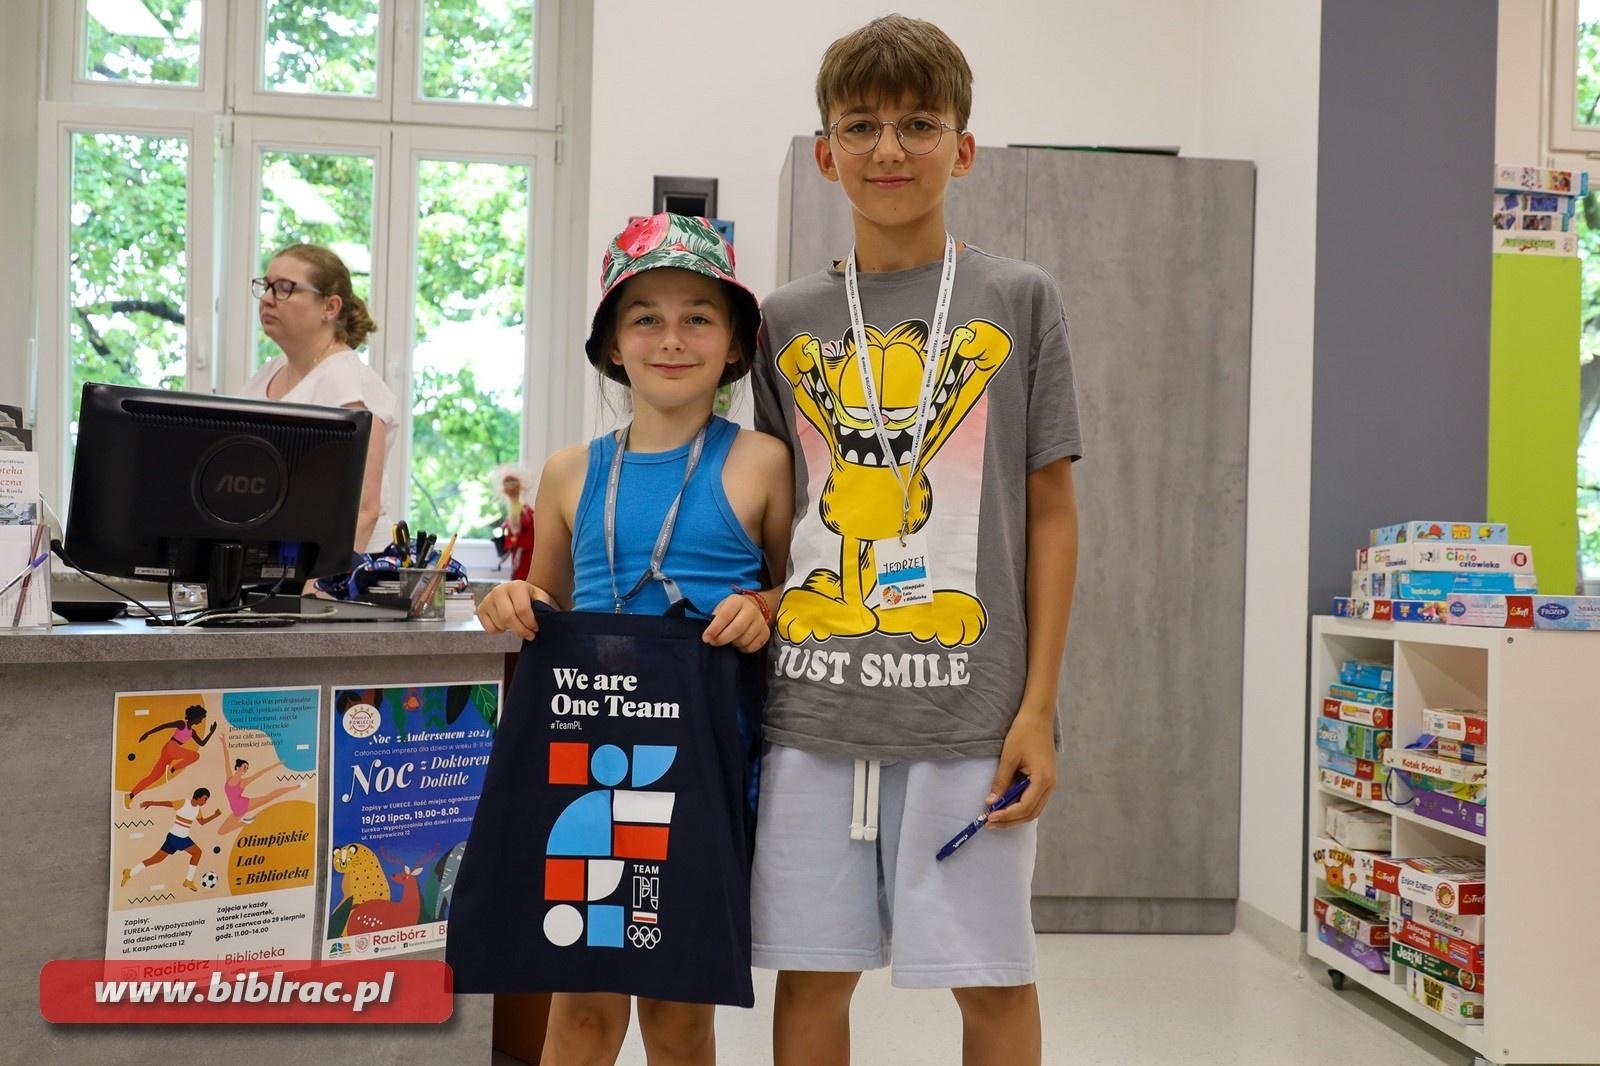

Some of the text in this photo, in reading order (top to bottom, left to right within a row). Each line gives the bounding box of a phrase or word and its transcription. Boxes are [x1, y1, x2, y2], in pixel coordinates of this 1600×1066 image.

[216, 475, 266, 494] AOC
[774, 646, 971, 688] JUST SMILE
[552, 667, 638, 691] We are
[551, 693, 680, 719] One Team
[550, 720, 582, 731] #TeamPL
[369, 733, 391, 745] Noc
[402, 730, 465, 743] Andersenem
[467, 729, 490, 739] 2024
[418, 744, 429, 752] dla
[420, 762, 428, 770] z
[1402, 758, 1442, 775] Kotek Psotek
[342, 758, 415, 803] Noc
[420, 772, 470, 789] Dolittle
[361, 807, 460, 825] 19/20 lipca, 19.00-8.00
[237, 831, 309, 849] Olimpijskie
[236, 854, 265, 867] Lato
[236, 867, 310, 886] z Biblioteką
[633, 864, 660, 875] TEAM
[1382, 872, 1396, 884] Trefl
[1471, 894, 1485, 904] Tref
[124, 918, 150, 926] Zapisy:
[216, 913, 239, 922] wtorek
[234, 920, 261, 928] czerwca
[280, 913, 306, 921] sierpnia
[136, 935, 157, 943] dzieci
[215, 933, 233, 942] godz.
[373, 929, 427, 946] Racibórz
[132, 942, 177, 953] Kasprowicza
[225, 946, 286, 966] Biblioteka
